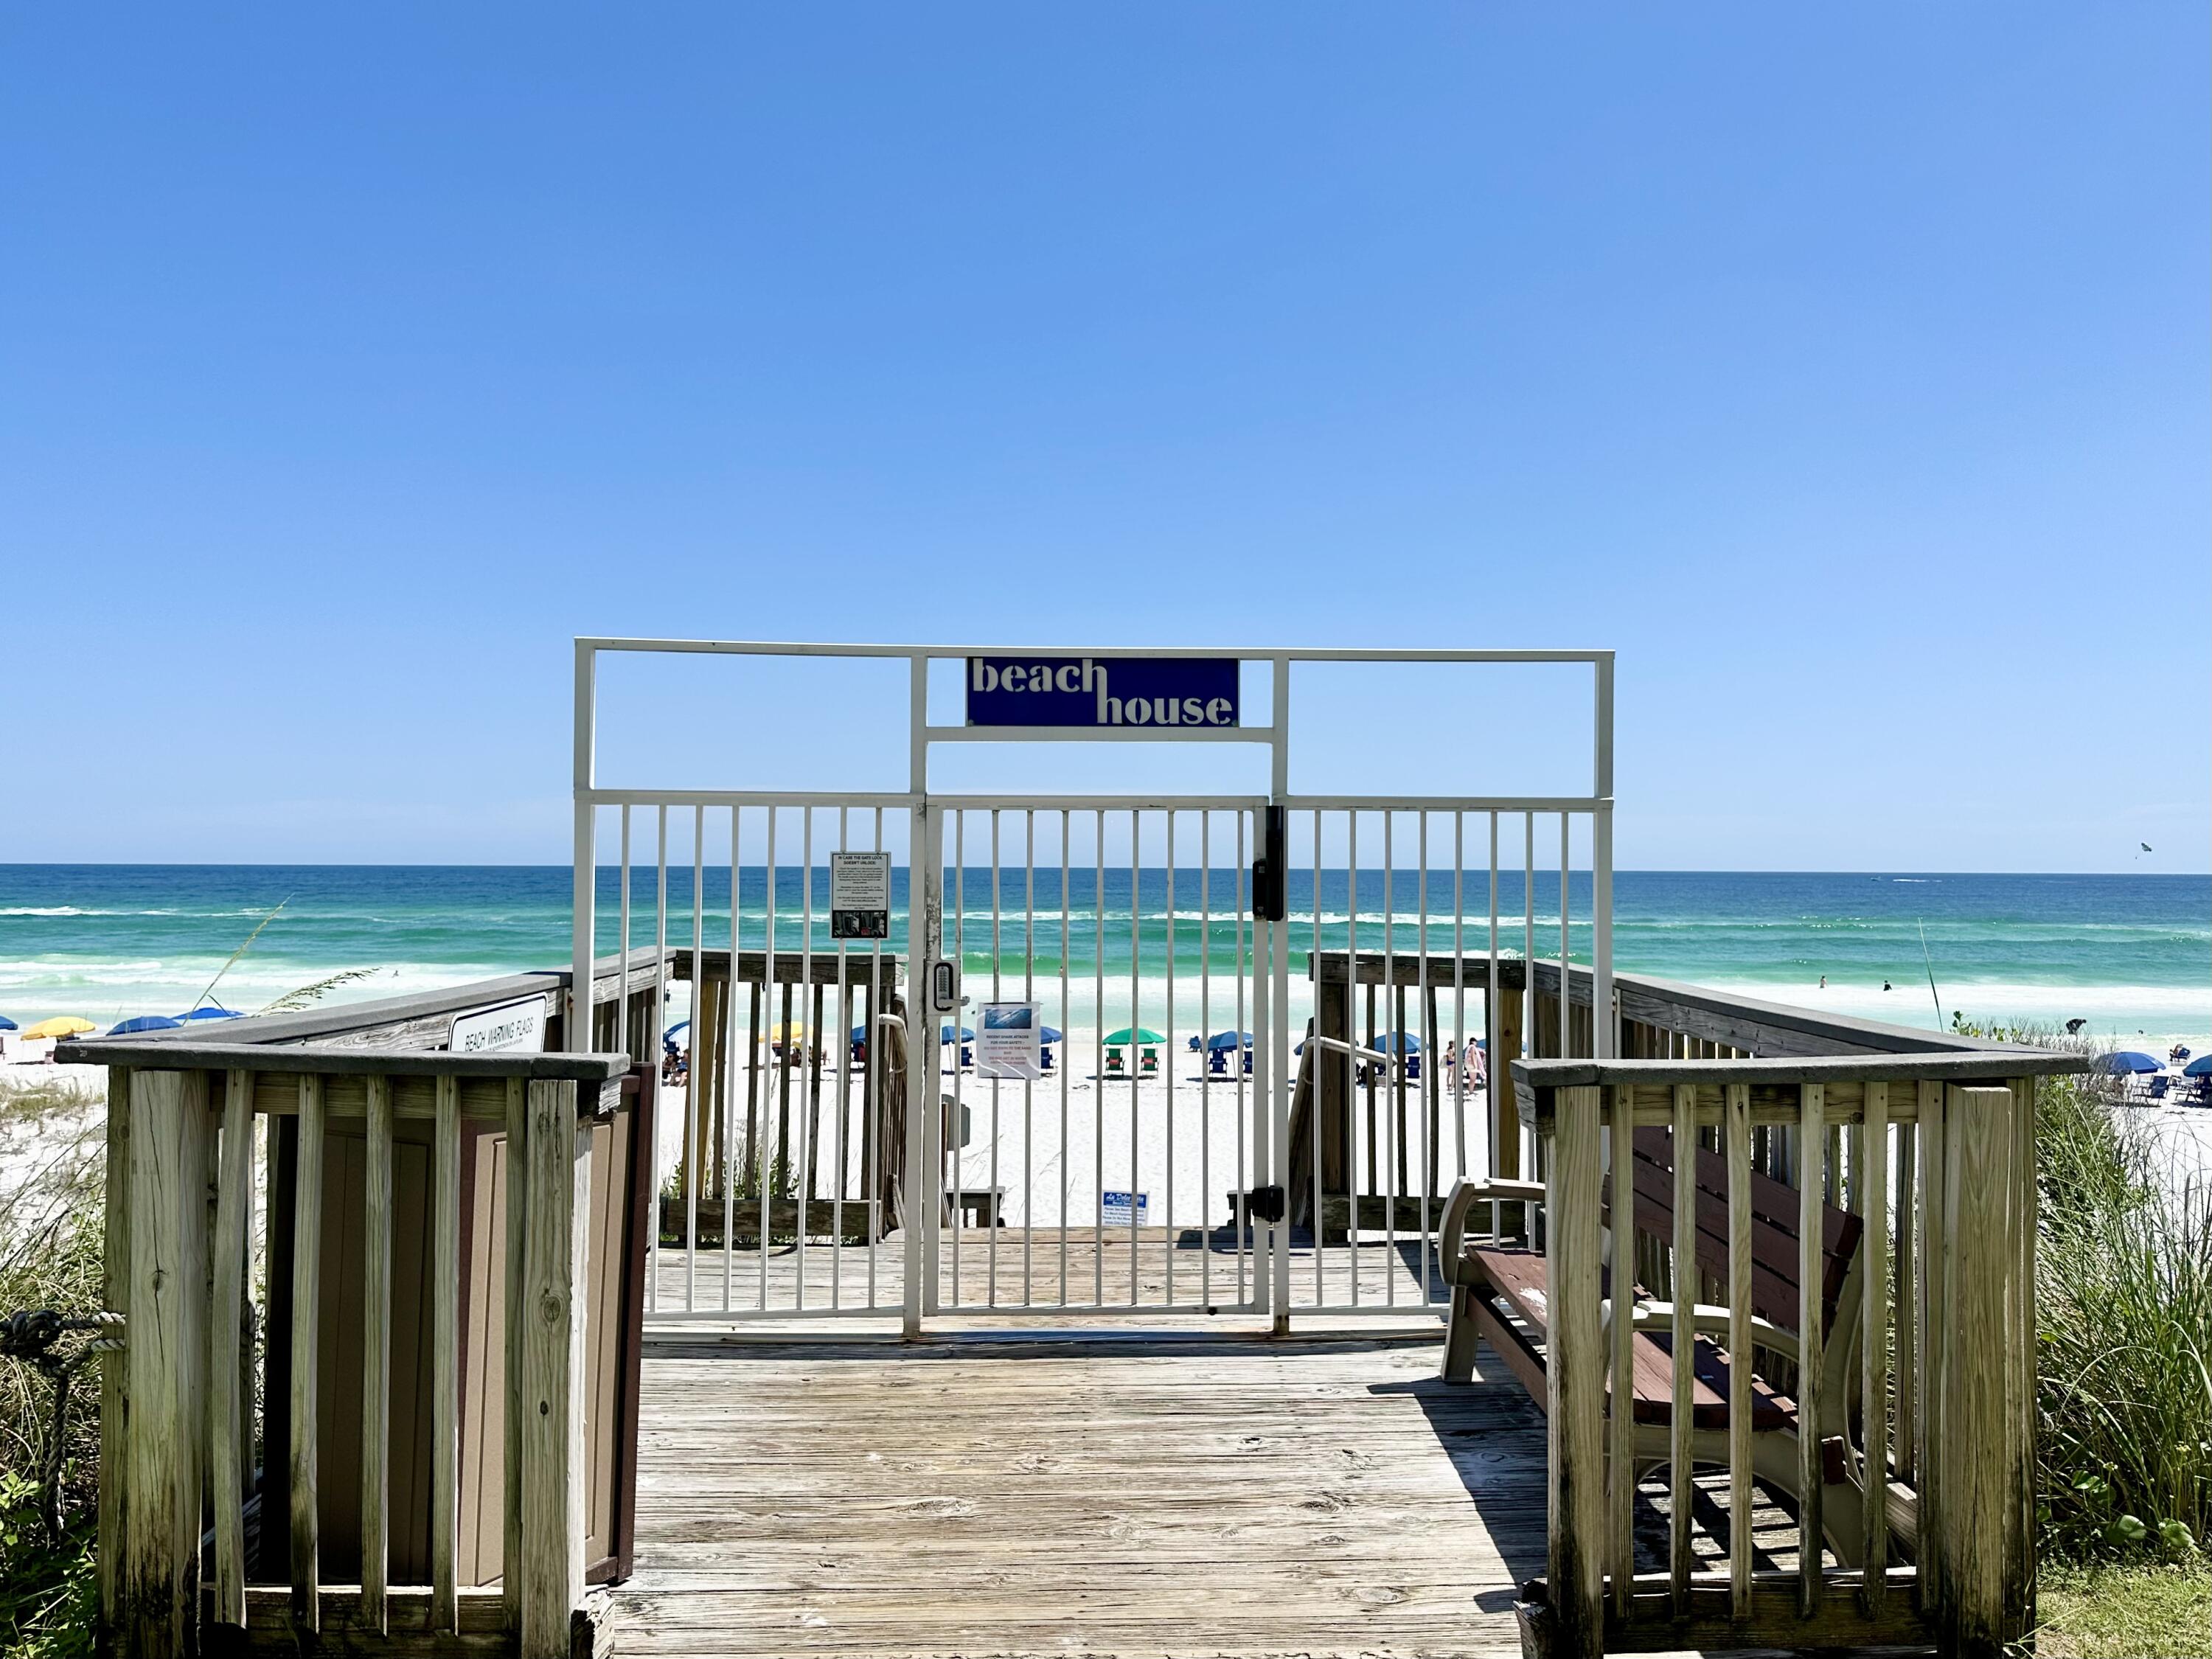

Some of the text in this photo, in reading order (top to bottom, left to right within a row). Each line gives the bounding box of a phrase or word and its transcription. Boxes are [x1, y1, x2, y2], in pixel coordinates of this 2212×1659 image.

[973, 658, 1107, 704] beach
[1097, 686, 1233, 725] house
[465, 1030, 486, 1051] BEACH
[488, 1022, 515, 1045] WARNING
[516, 1017, 534, 1037] FLAGS
